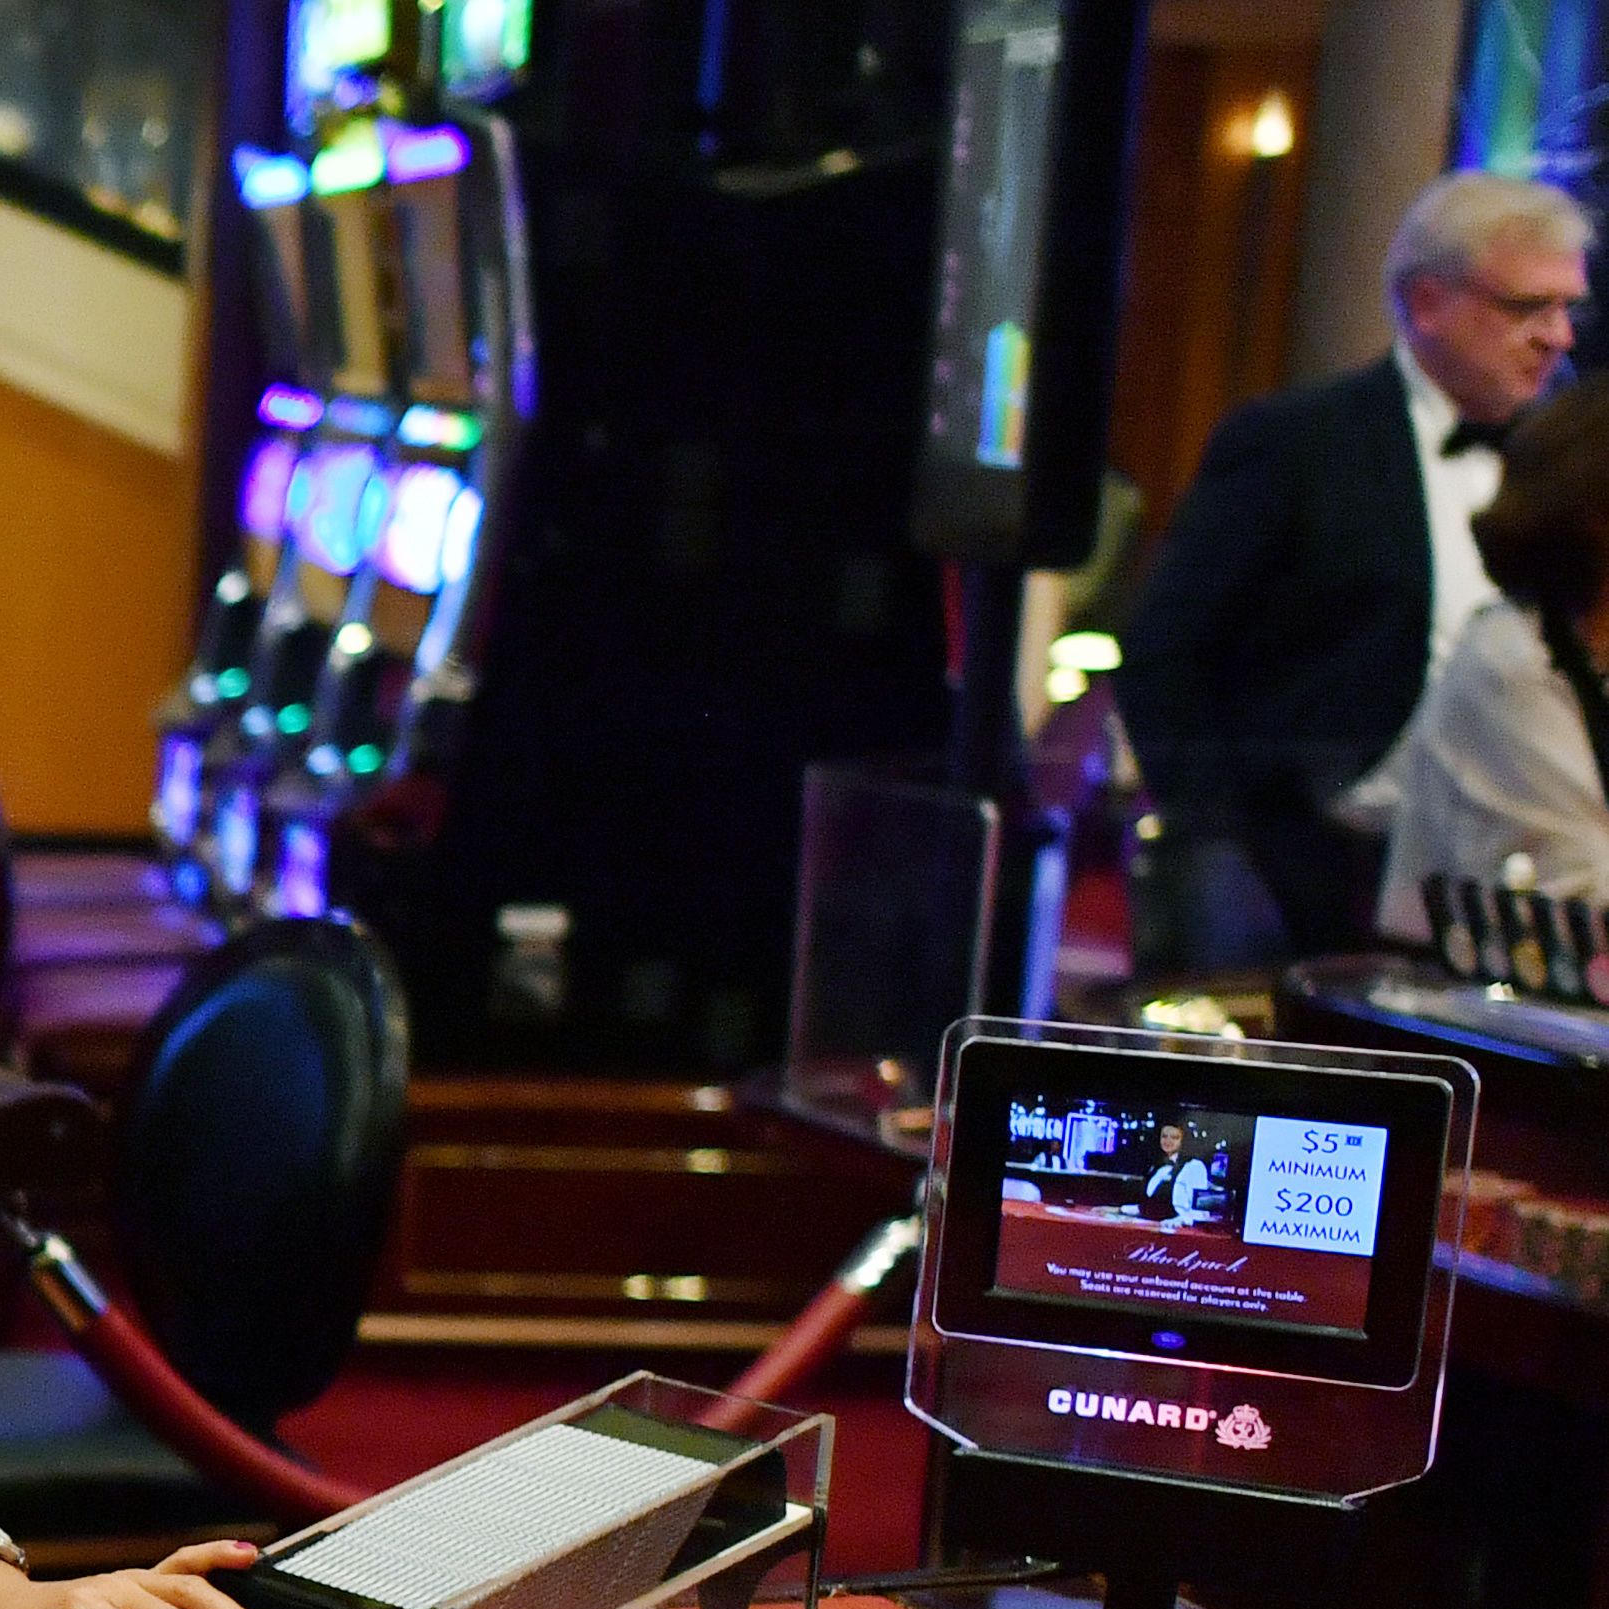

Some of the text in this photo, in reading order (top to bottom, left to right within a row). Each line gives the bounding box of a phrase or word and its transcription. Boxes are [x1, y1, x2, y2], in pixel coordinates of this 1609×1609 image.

[1301, 1129, 1339, 1155] $5
[1267, 1160, 1367, 1182] MINIMUM
[1275, 1188, 1354, 1218] $200
[1260, 1220, 1361, 1244] MAXIMUM
[1046, 1262, 1068, 1275] You
[1069, 1266, 1092, 1280] may
[1116, 1273, 1139, 1285] your
[1189, 1282, 1236, 1296] account
[1238, 1286, 1250, 1297] at
[1252, 1286, 1273, 1300] this
[1079, 1279, 1111, 1293] Seats
[1113, 1285, 1132, 1296] are
[1133, 1286, 1181, 1301] reserved
[1183, 1290, 1198, 1303] for
[1200, 1293, 1241, 1309] players
[1047, 1388, 1210, 1432] CUNARD
